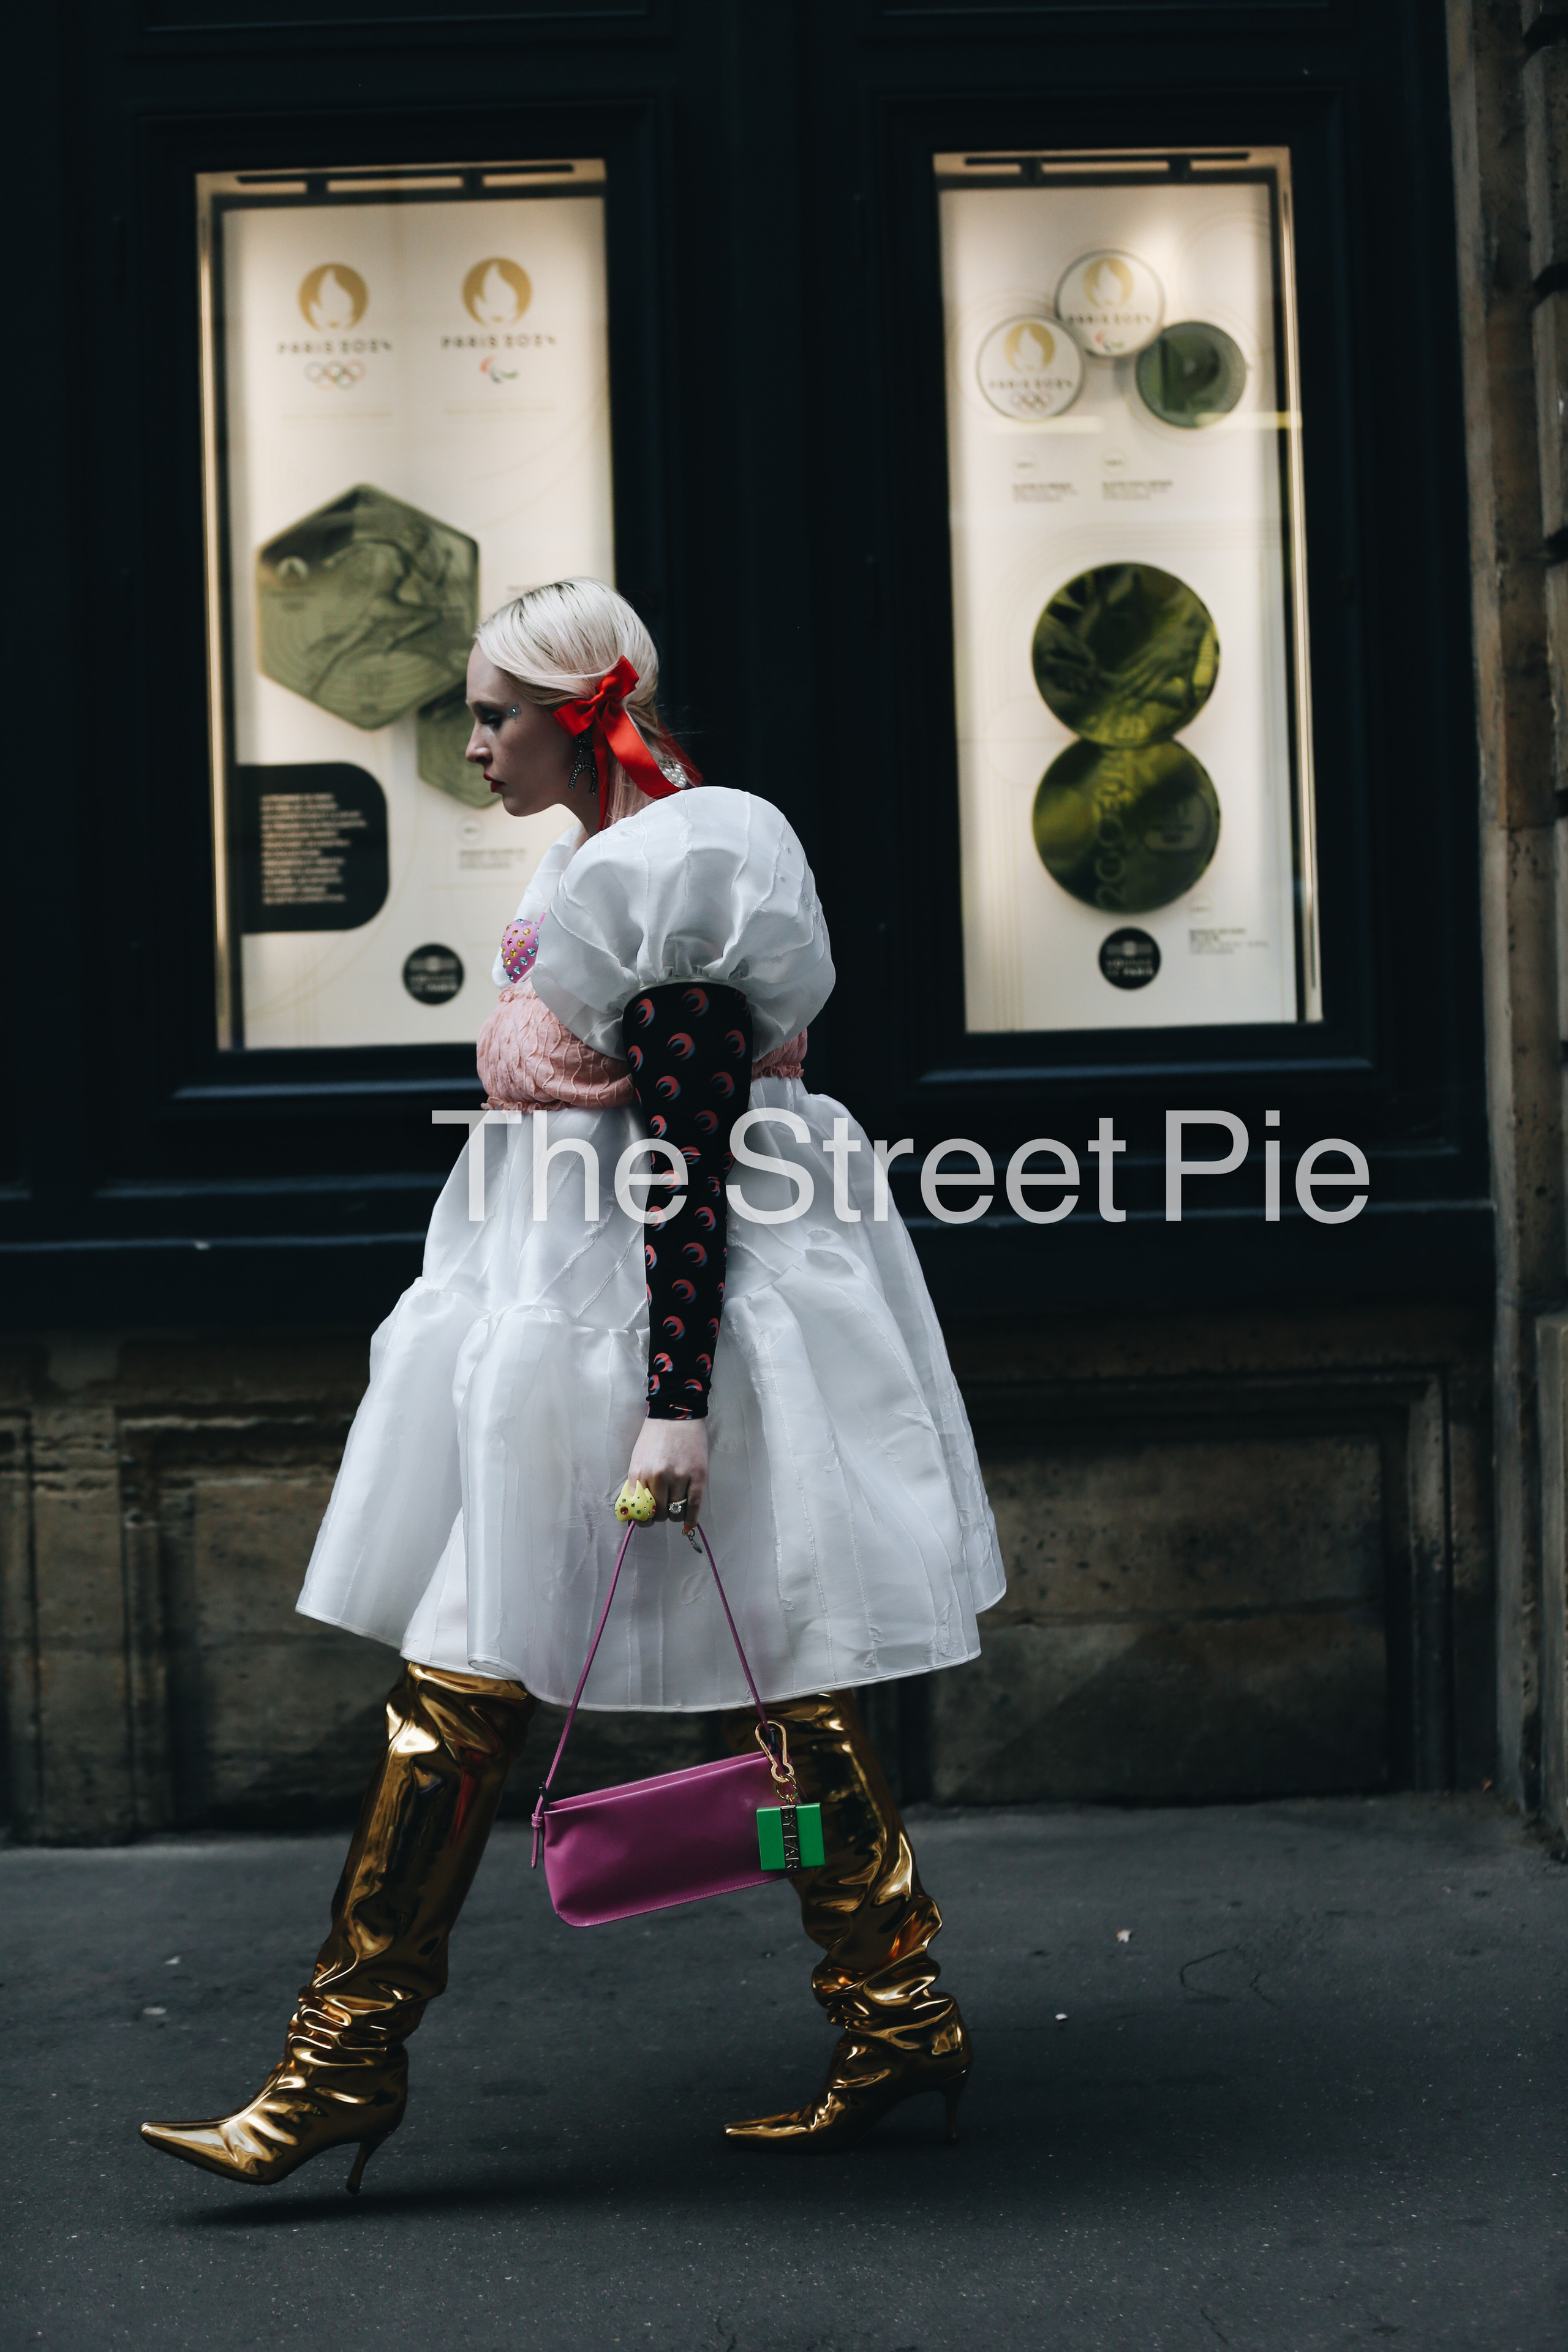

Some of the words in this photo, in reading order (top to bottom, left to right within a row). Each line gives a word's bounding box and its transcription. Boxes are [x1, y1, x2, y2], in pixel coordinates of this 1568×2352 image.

[277, 339, 333, 355] PARIS
[340, 337, 393, 354] 2024
[440, 334, 497, 350] PARIS
[503, 333, 557, 349] 2024
[782, 1806, 796, 1830] BY
[784, 1835, 799, 1869] FAR
